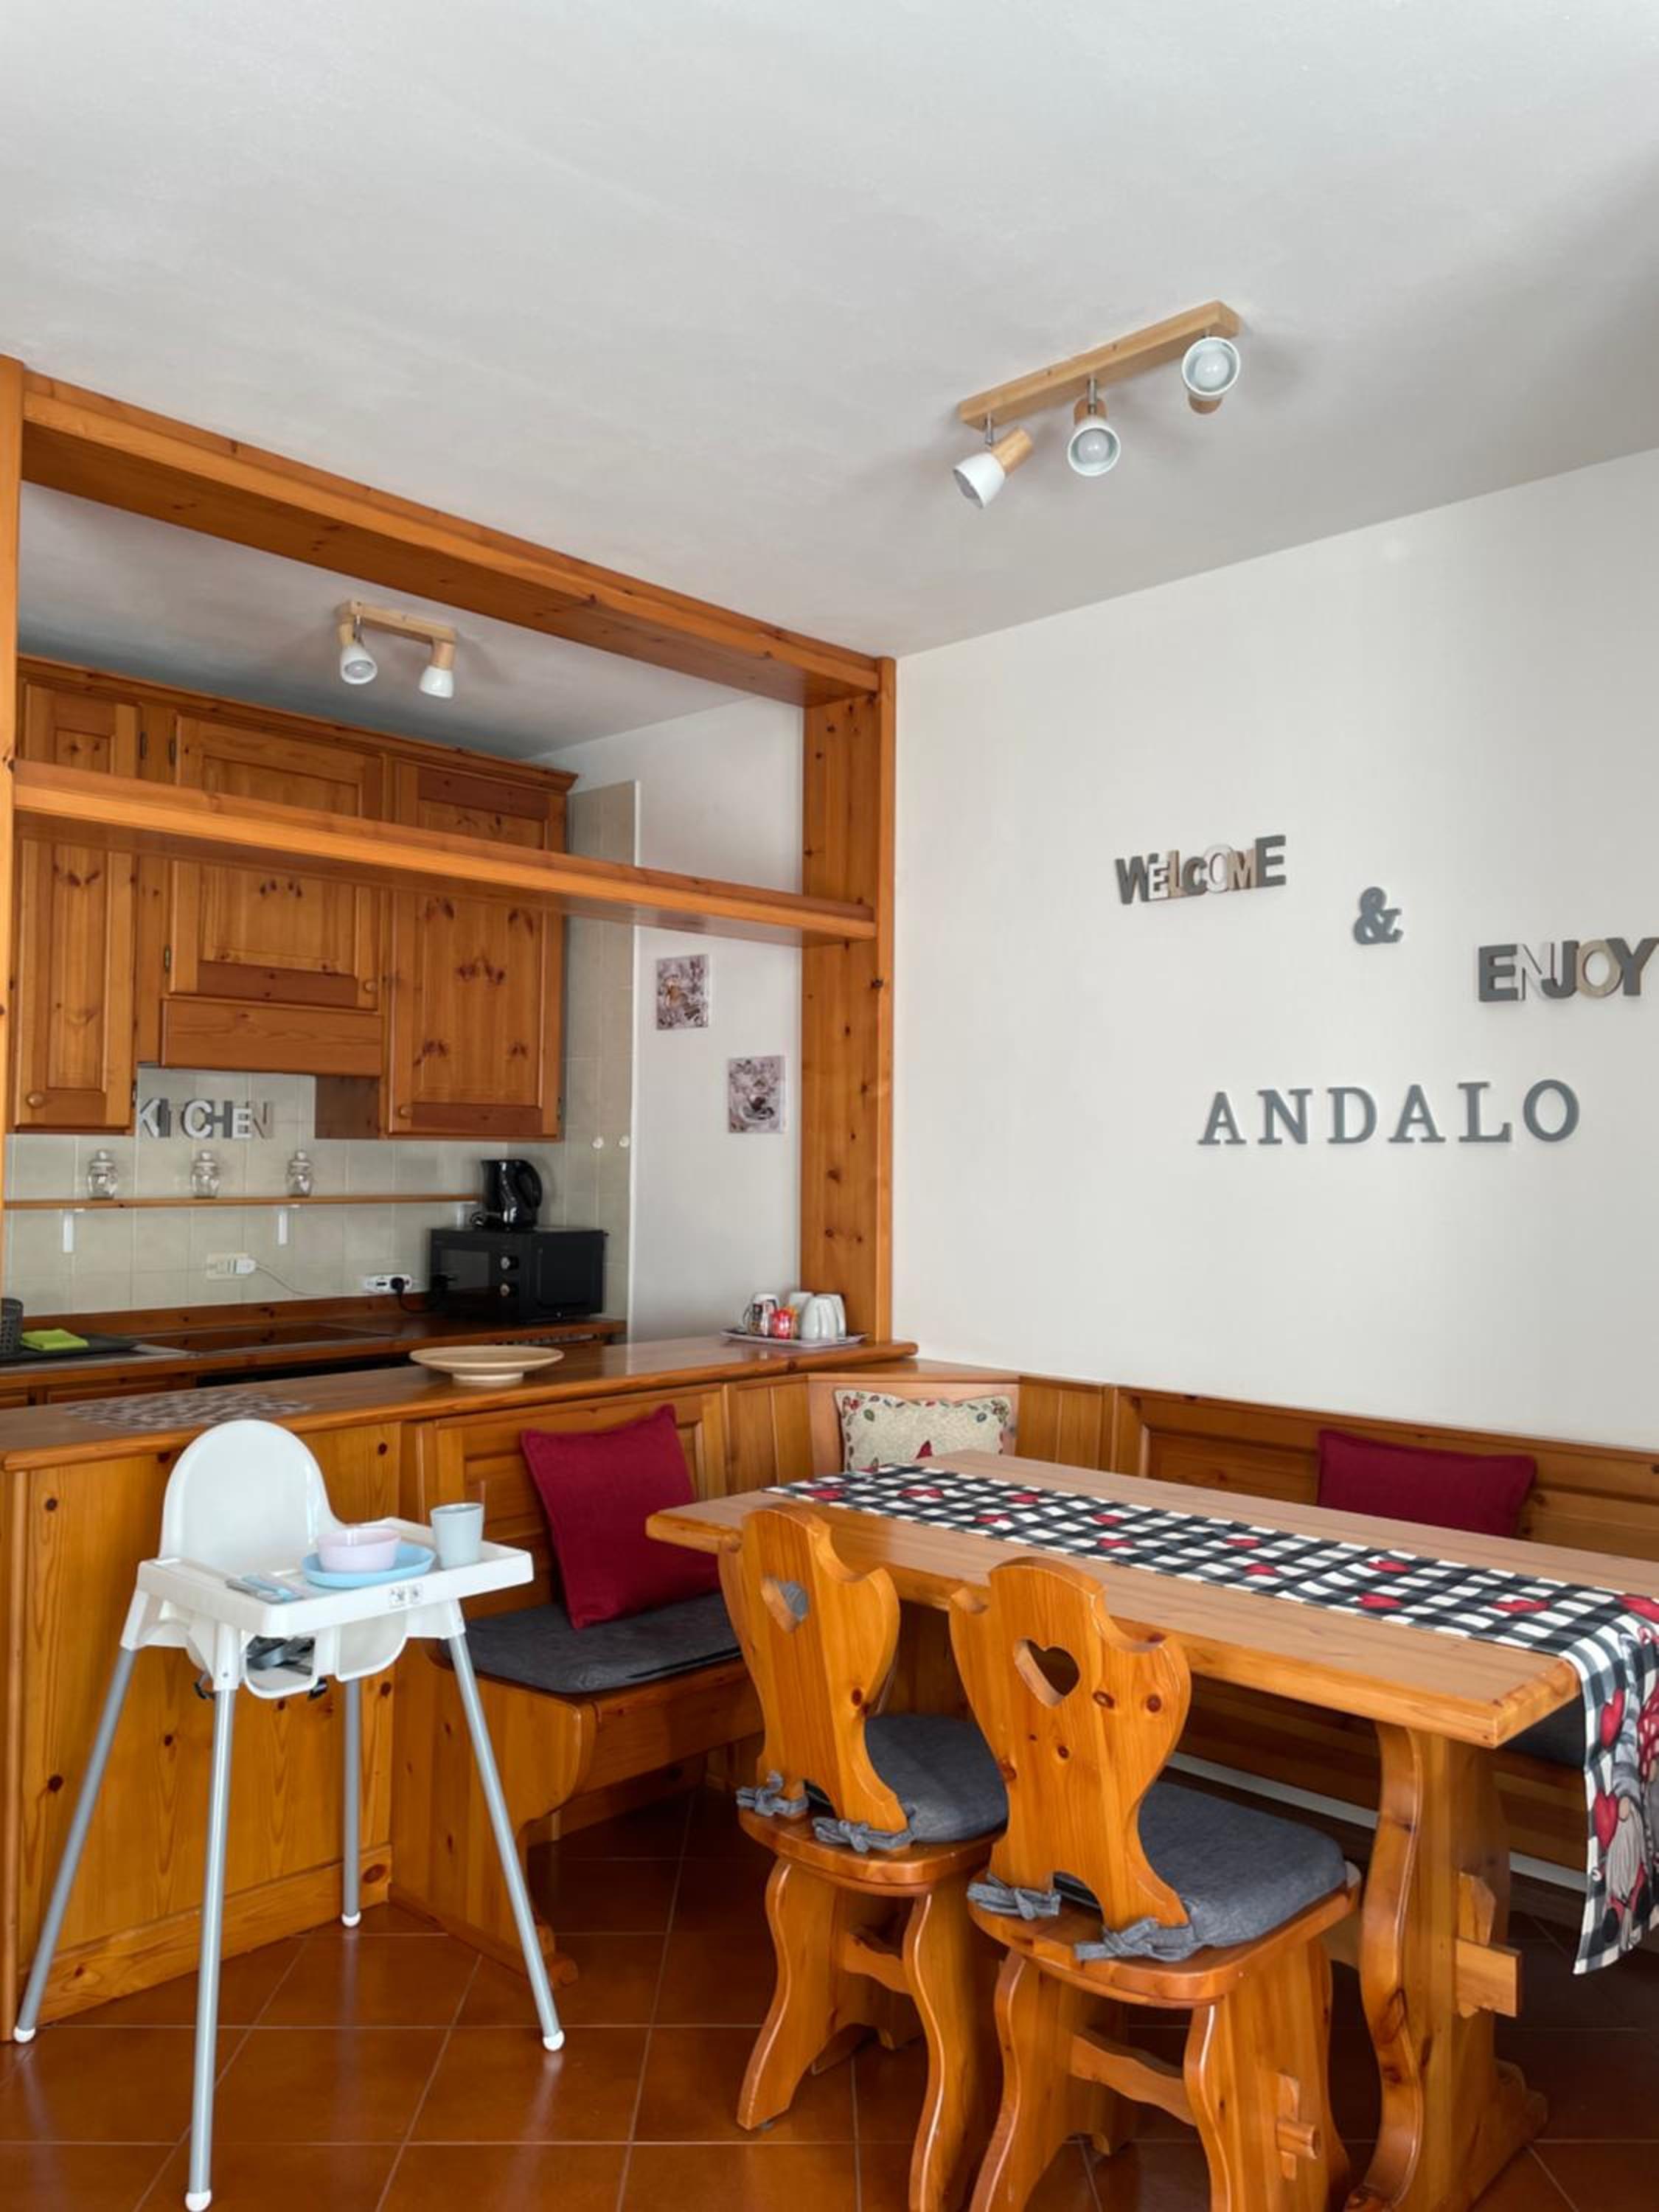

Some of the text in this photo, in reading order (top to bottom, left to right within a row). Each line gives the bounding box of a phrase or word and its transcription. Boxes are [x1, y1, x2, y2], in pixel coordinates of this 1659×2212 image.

[1115, 834, 1287, 905] WELCOME
[1352, 887, 1402, 945] &
[1478, 936, 1659, 1002] ENJOY
[1197, 1079, 1580, 1145] ANDALO
